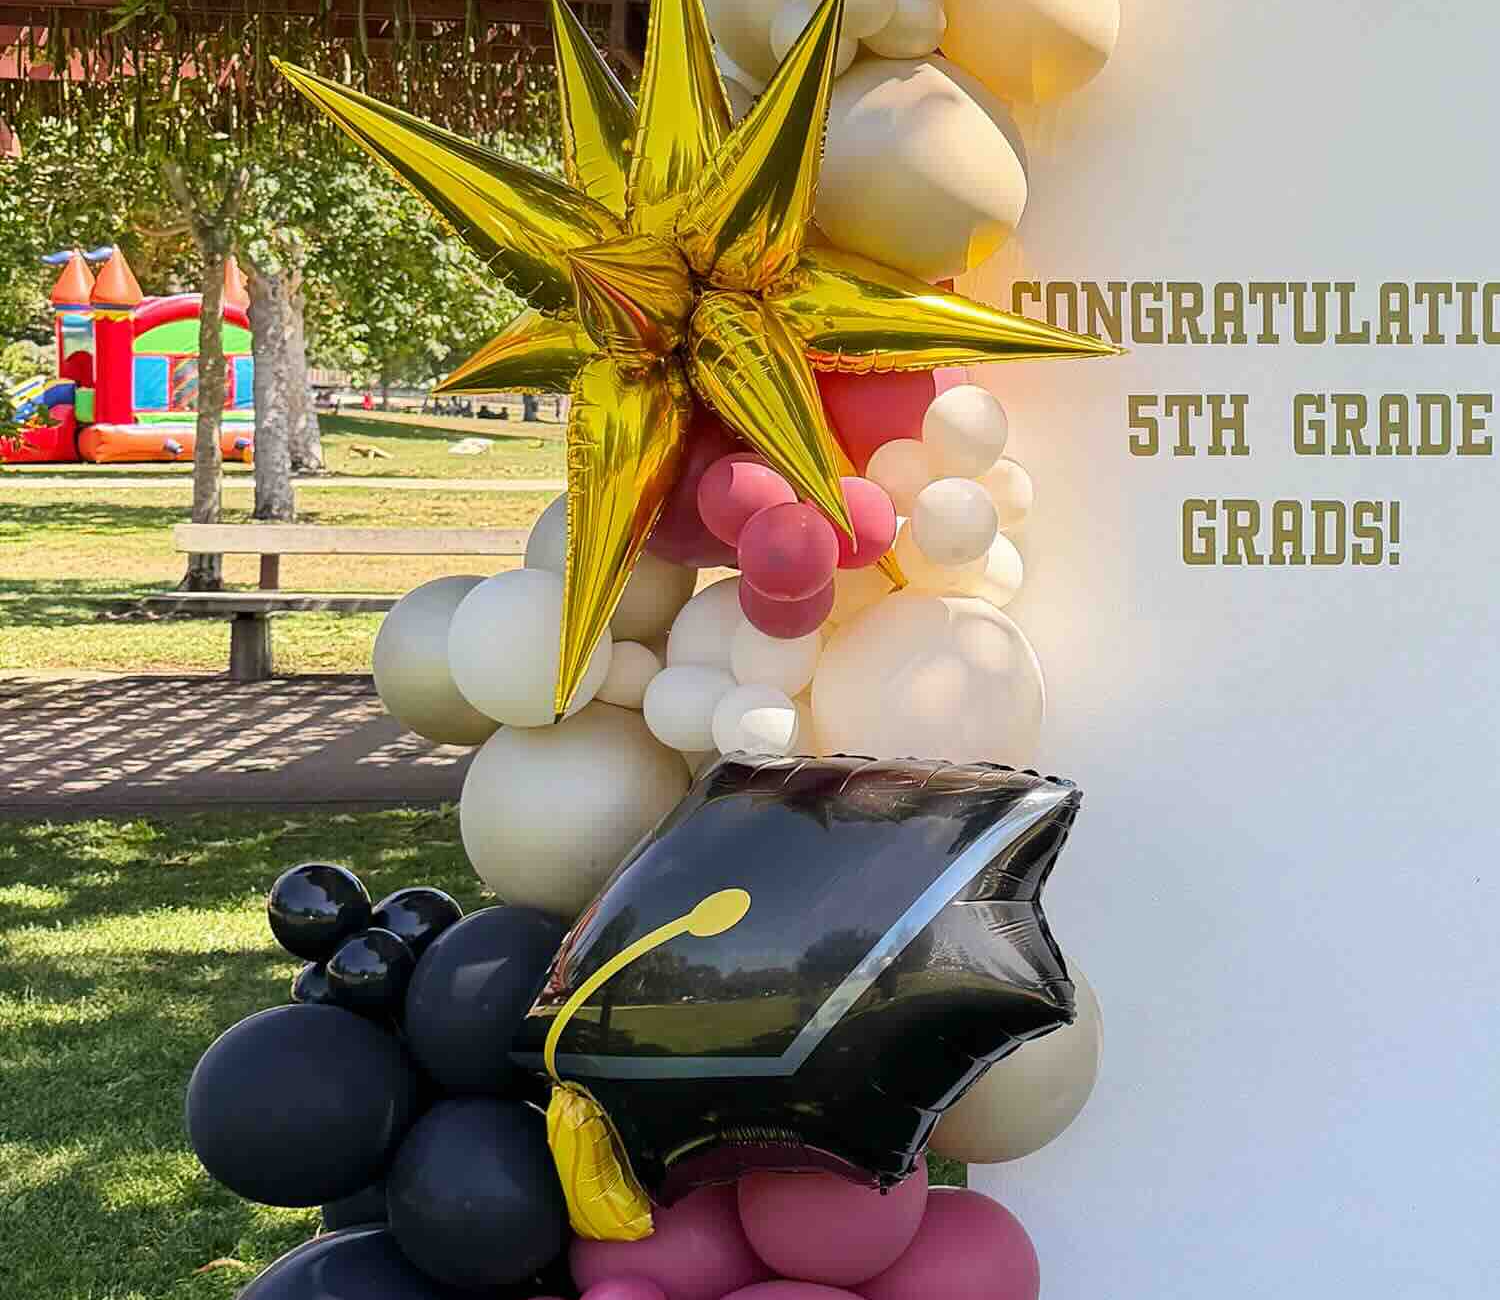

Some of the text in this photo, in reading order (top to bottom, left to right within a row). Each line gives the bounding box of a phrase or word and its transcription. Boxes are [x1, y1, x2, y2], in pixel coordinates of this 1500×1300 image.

[1128, 394, 1493, 456] 5TH GRADE
[1181, 498, 1401, 566] GRADS!
